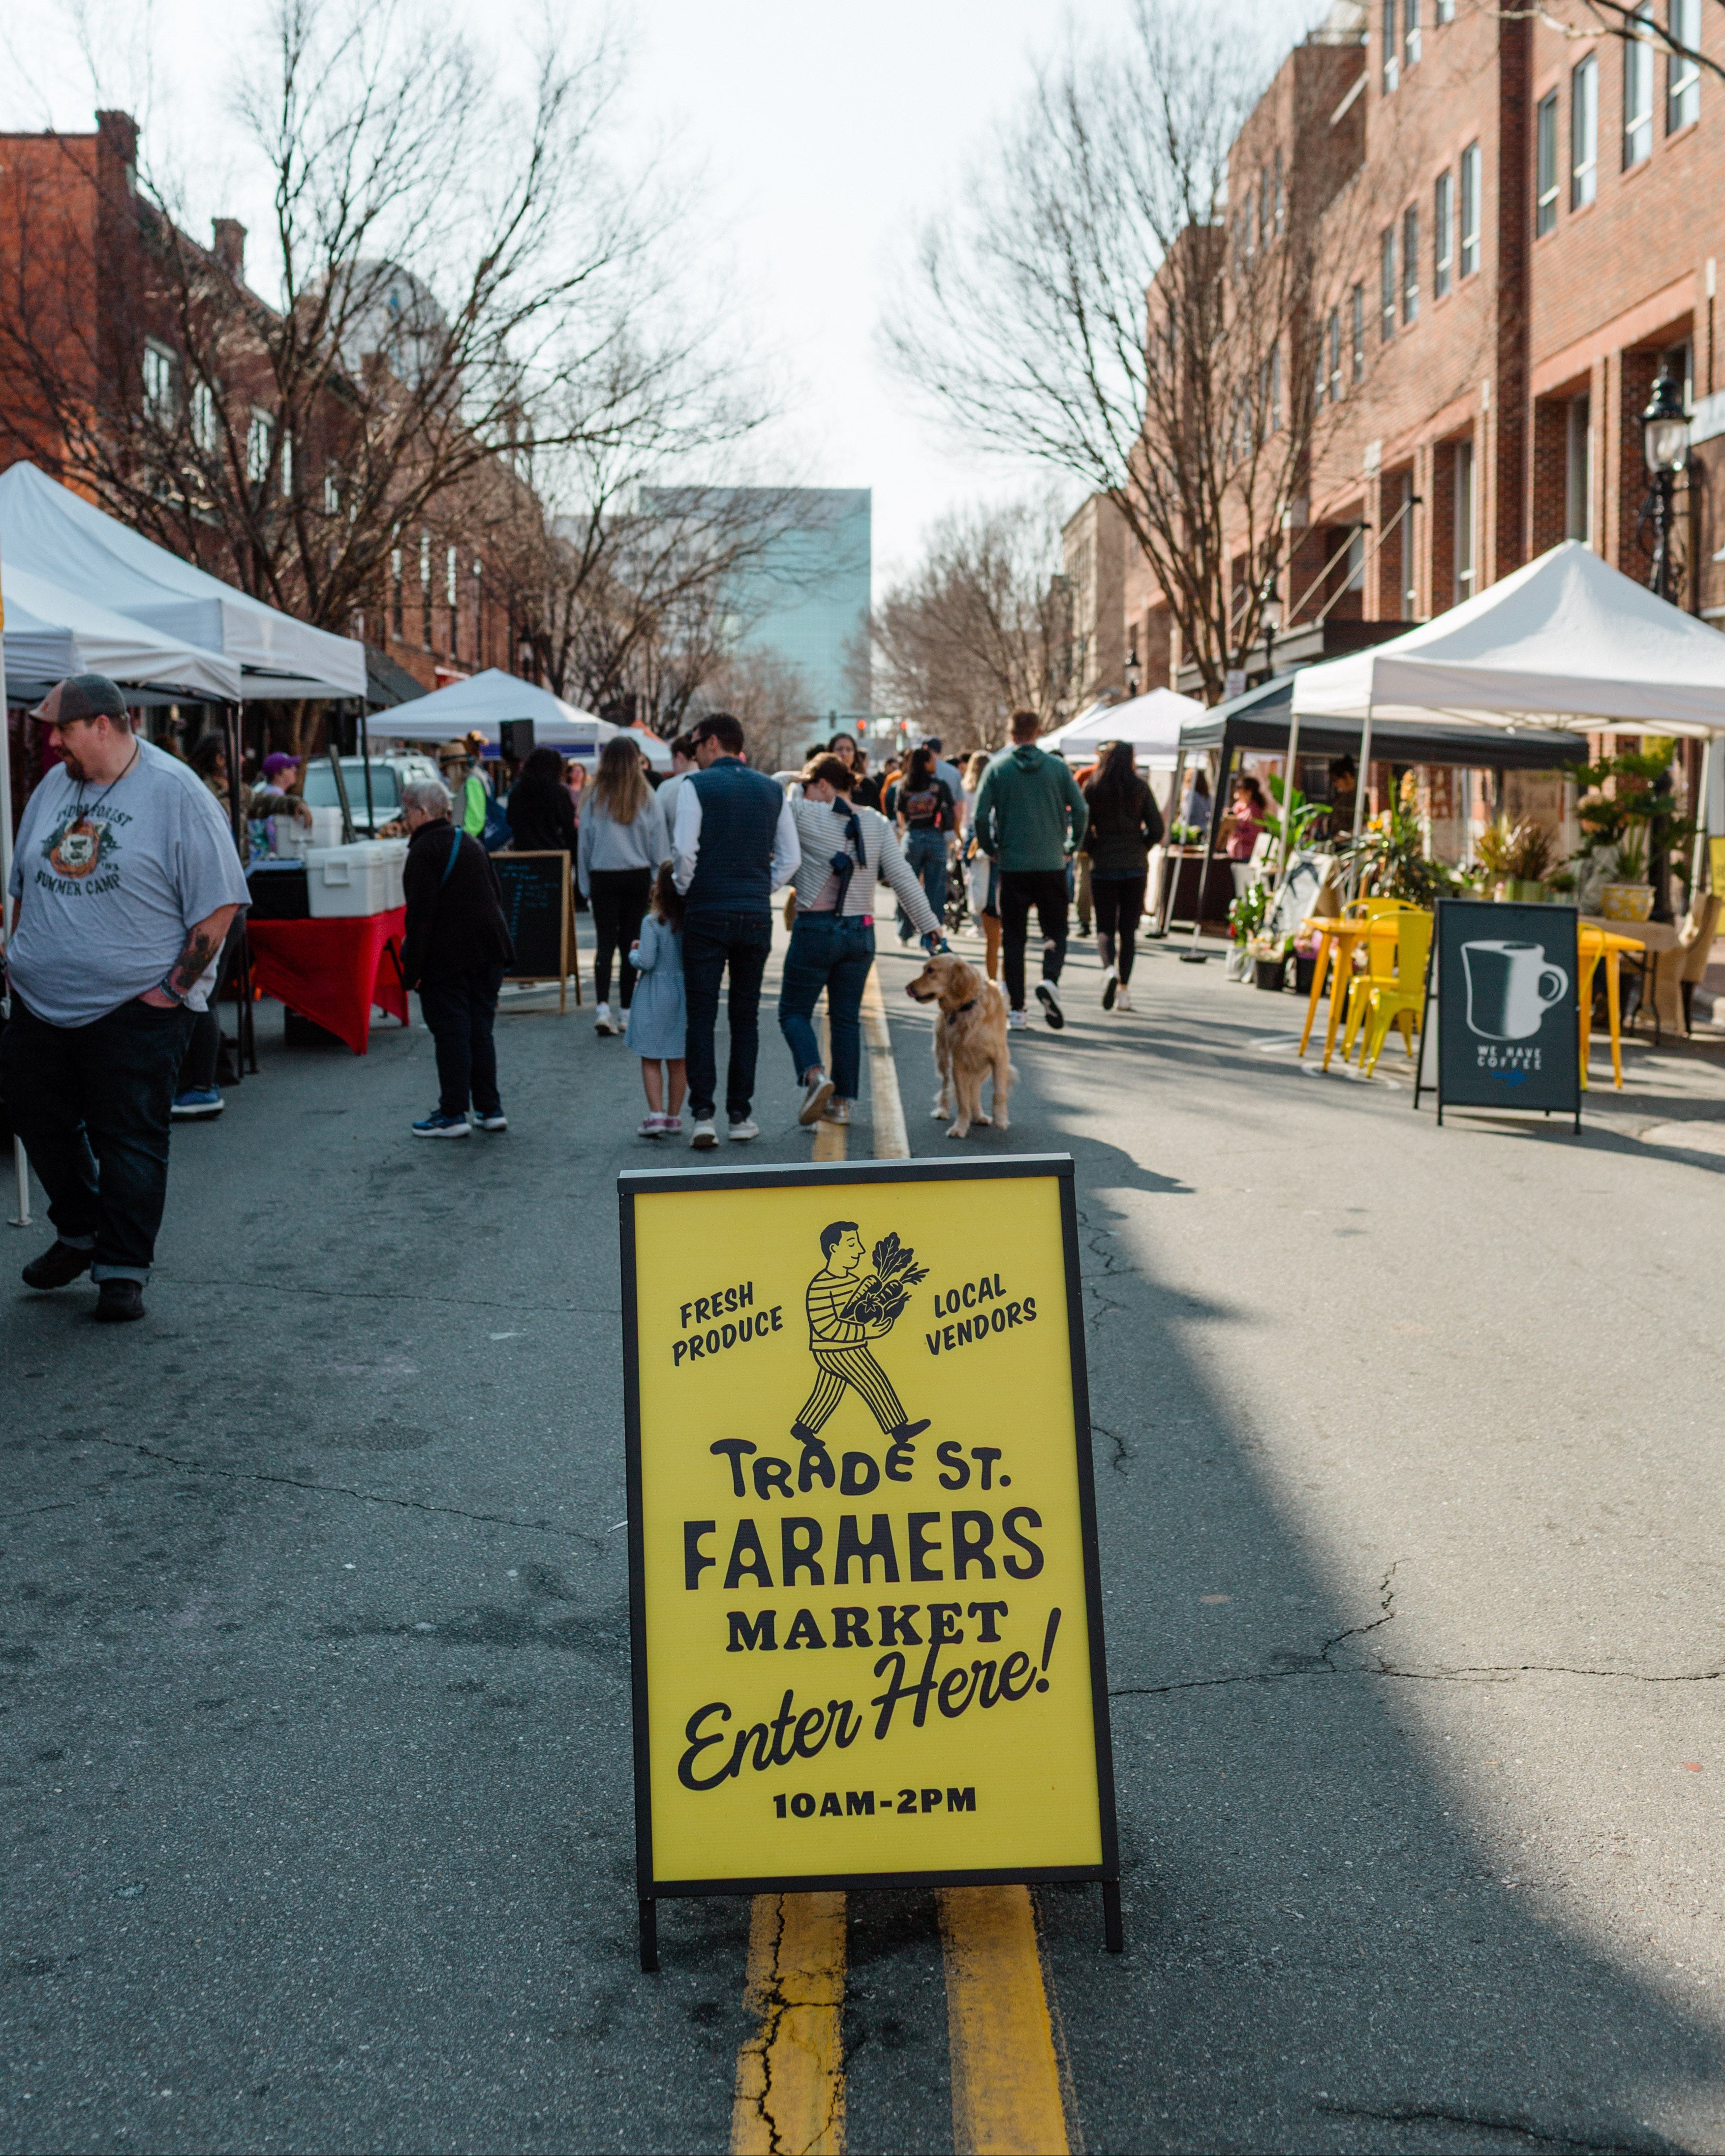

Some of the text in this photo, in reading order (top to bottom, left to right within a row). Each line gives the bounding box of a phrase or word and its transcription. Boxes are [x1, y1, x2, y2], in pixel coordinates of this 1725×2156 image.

[34, 869, 121, 896] SUMMER CAMP
[1477, 1045, 1542, 1059] WE HAVE
[1477, 1056, 1542, 1070] COFFEE
[680, 1281, 753, 1328] FRESH
[935, 1274, 1006, 1318] LOCAL
[672, 1306, 783, 1366] PRODUCE
[926, 1297, 1037, 1355] VENDORS
[710, 1438, 1011, 1500] TRADE ST.
[684, 1507, 1044, 1590] FARMERS
[726, 1601, 1008, 1652] MARKET
[678, 1608, 1061, 1791] Enter Here!
[773, 1787, 976, 1818] 10AM-2PM
